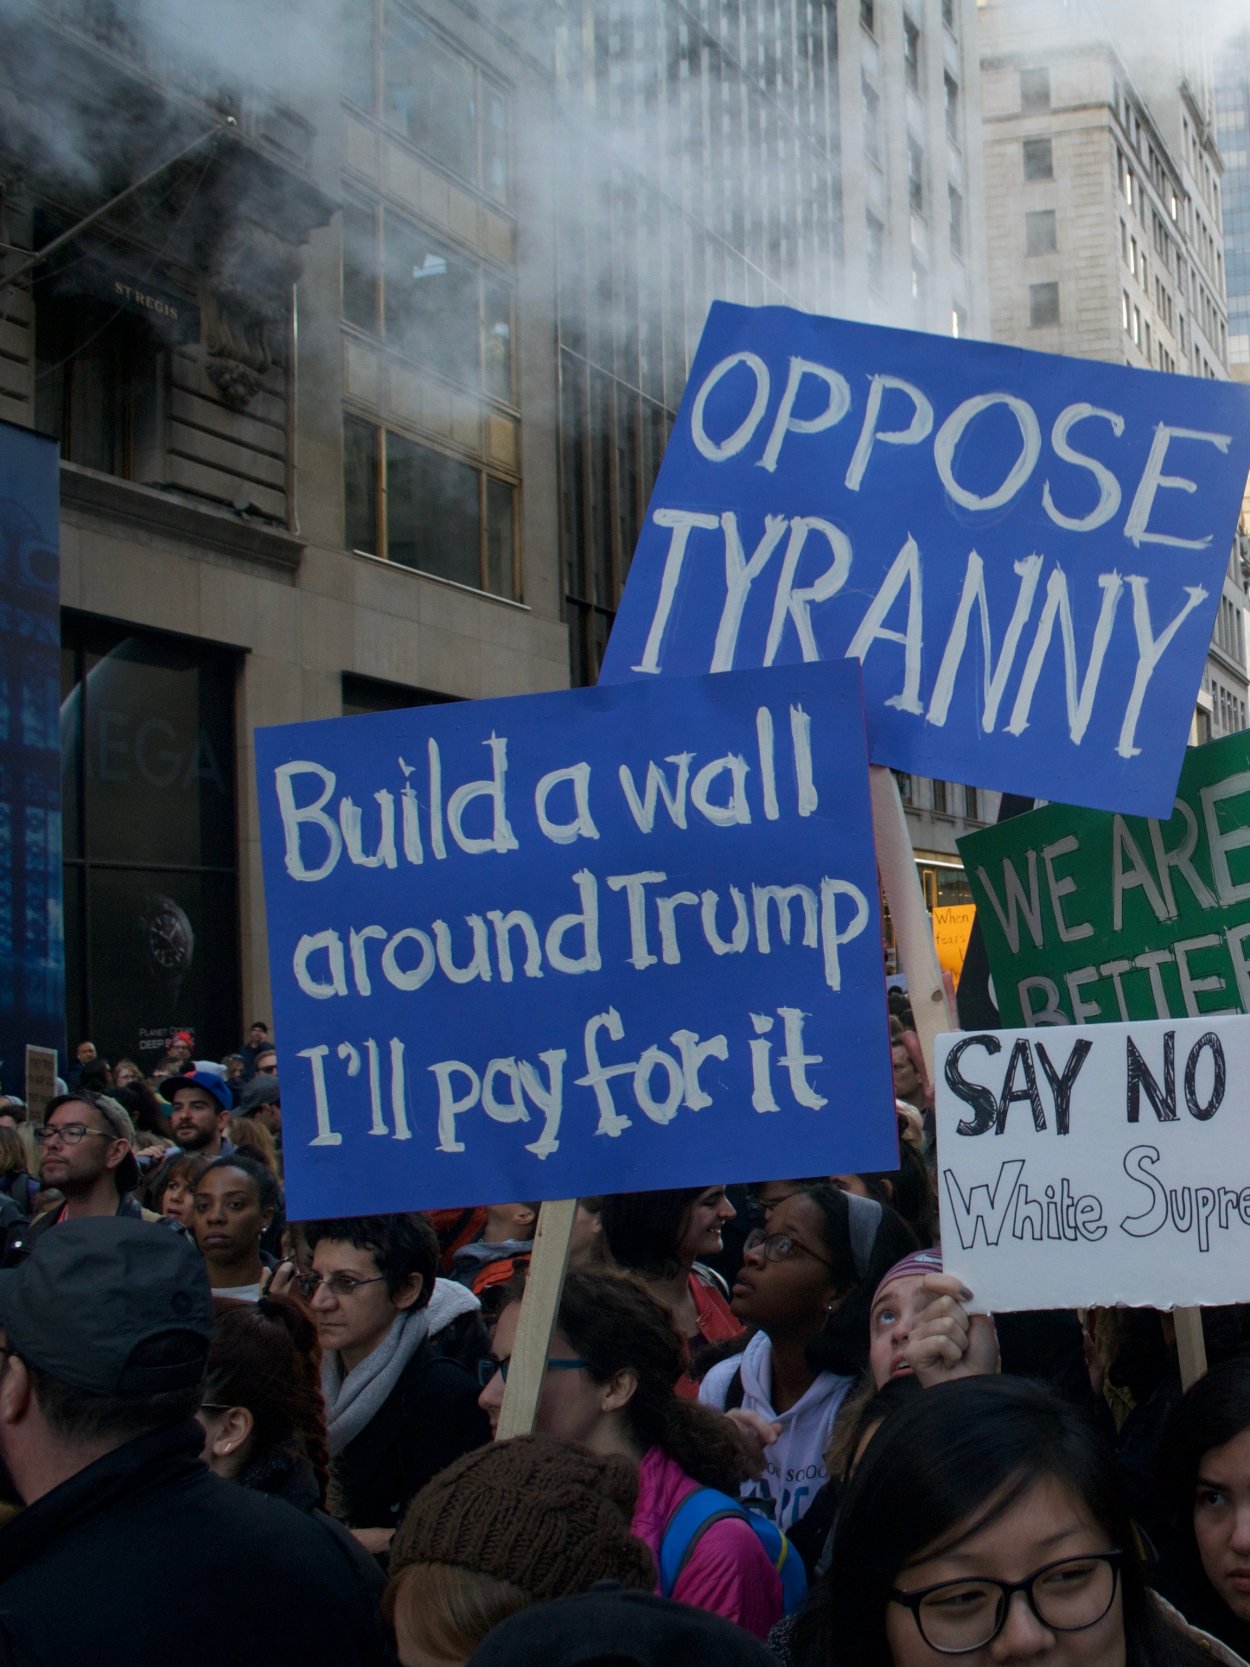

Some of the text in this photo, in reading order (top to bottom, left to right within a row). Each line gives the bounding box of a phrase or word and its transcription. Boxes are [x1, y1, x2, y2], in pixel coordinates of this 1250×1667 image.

[135, 291, 178, 319] REGIS
[690, 350, 1232, 549] OPPOSE
[630, 507, 1209, 758] TYRANNY
[86, 710, 226, 795] EGA
[274, 703, 818, 882] Build a wall
[293, 868, 870, 999] around Trump
[934, 908, 969, 924] When
[976, 832, 1094, 954] WE
[139, 1028, 168, 1037] PLANET
[139, 1040, 164, 1050] DEEP
[296, 1004, 828, 1160] I'll pay for it
[944, 1034, 1093, 1136] SAY
[1126, 1030, 1227, 1122] NO
[943, 1159, 1107, 1249] White
